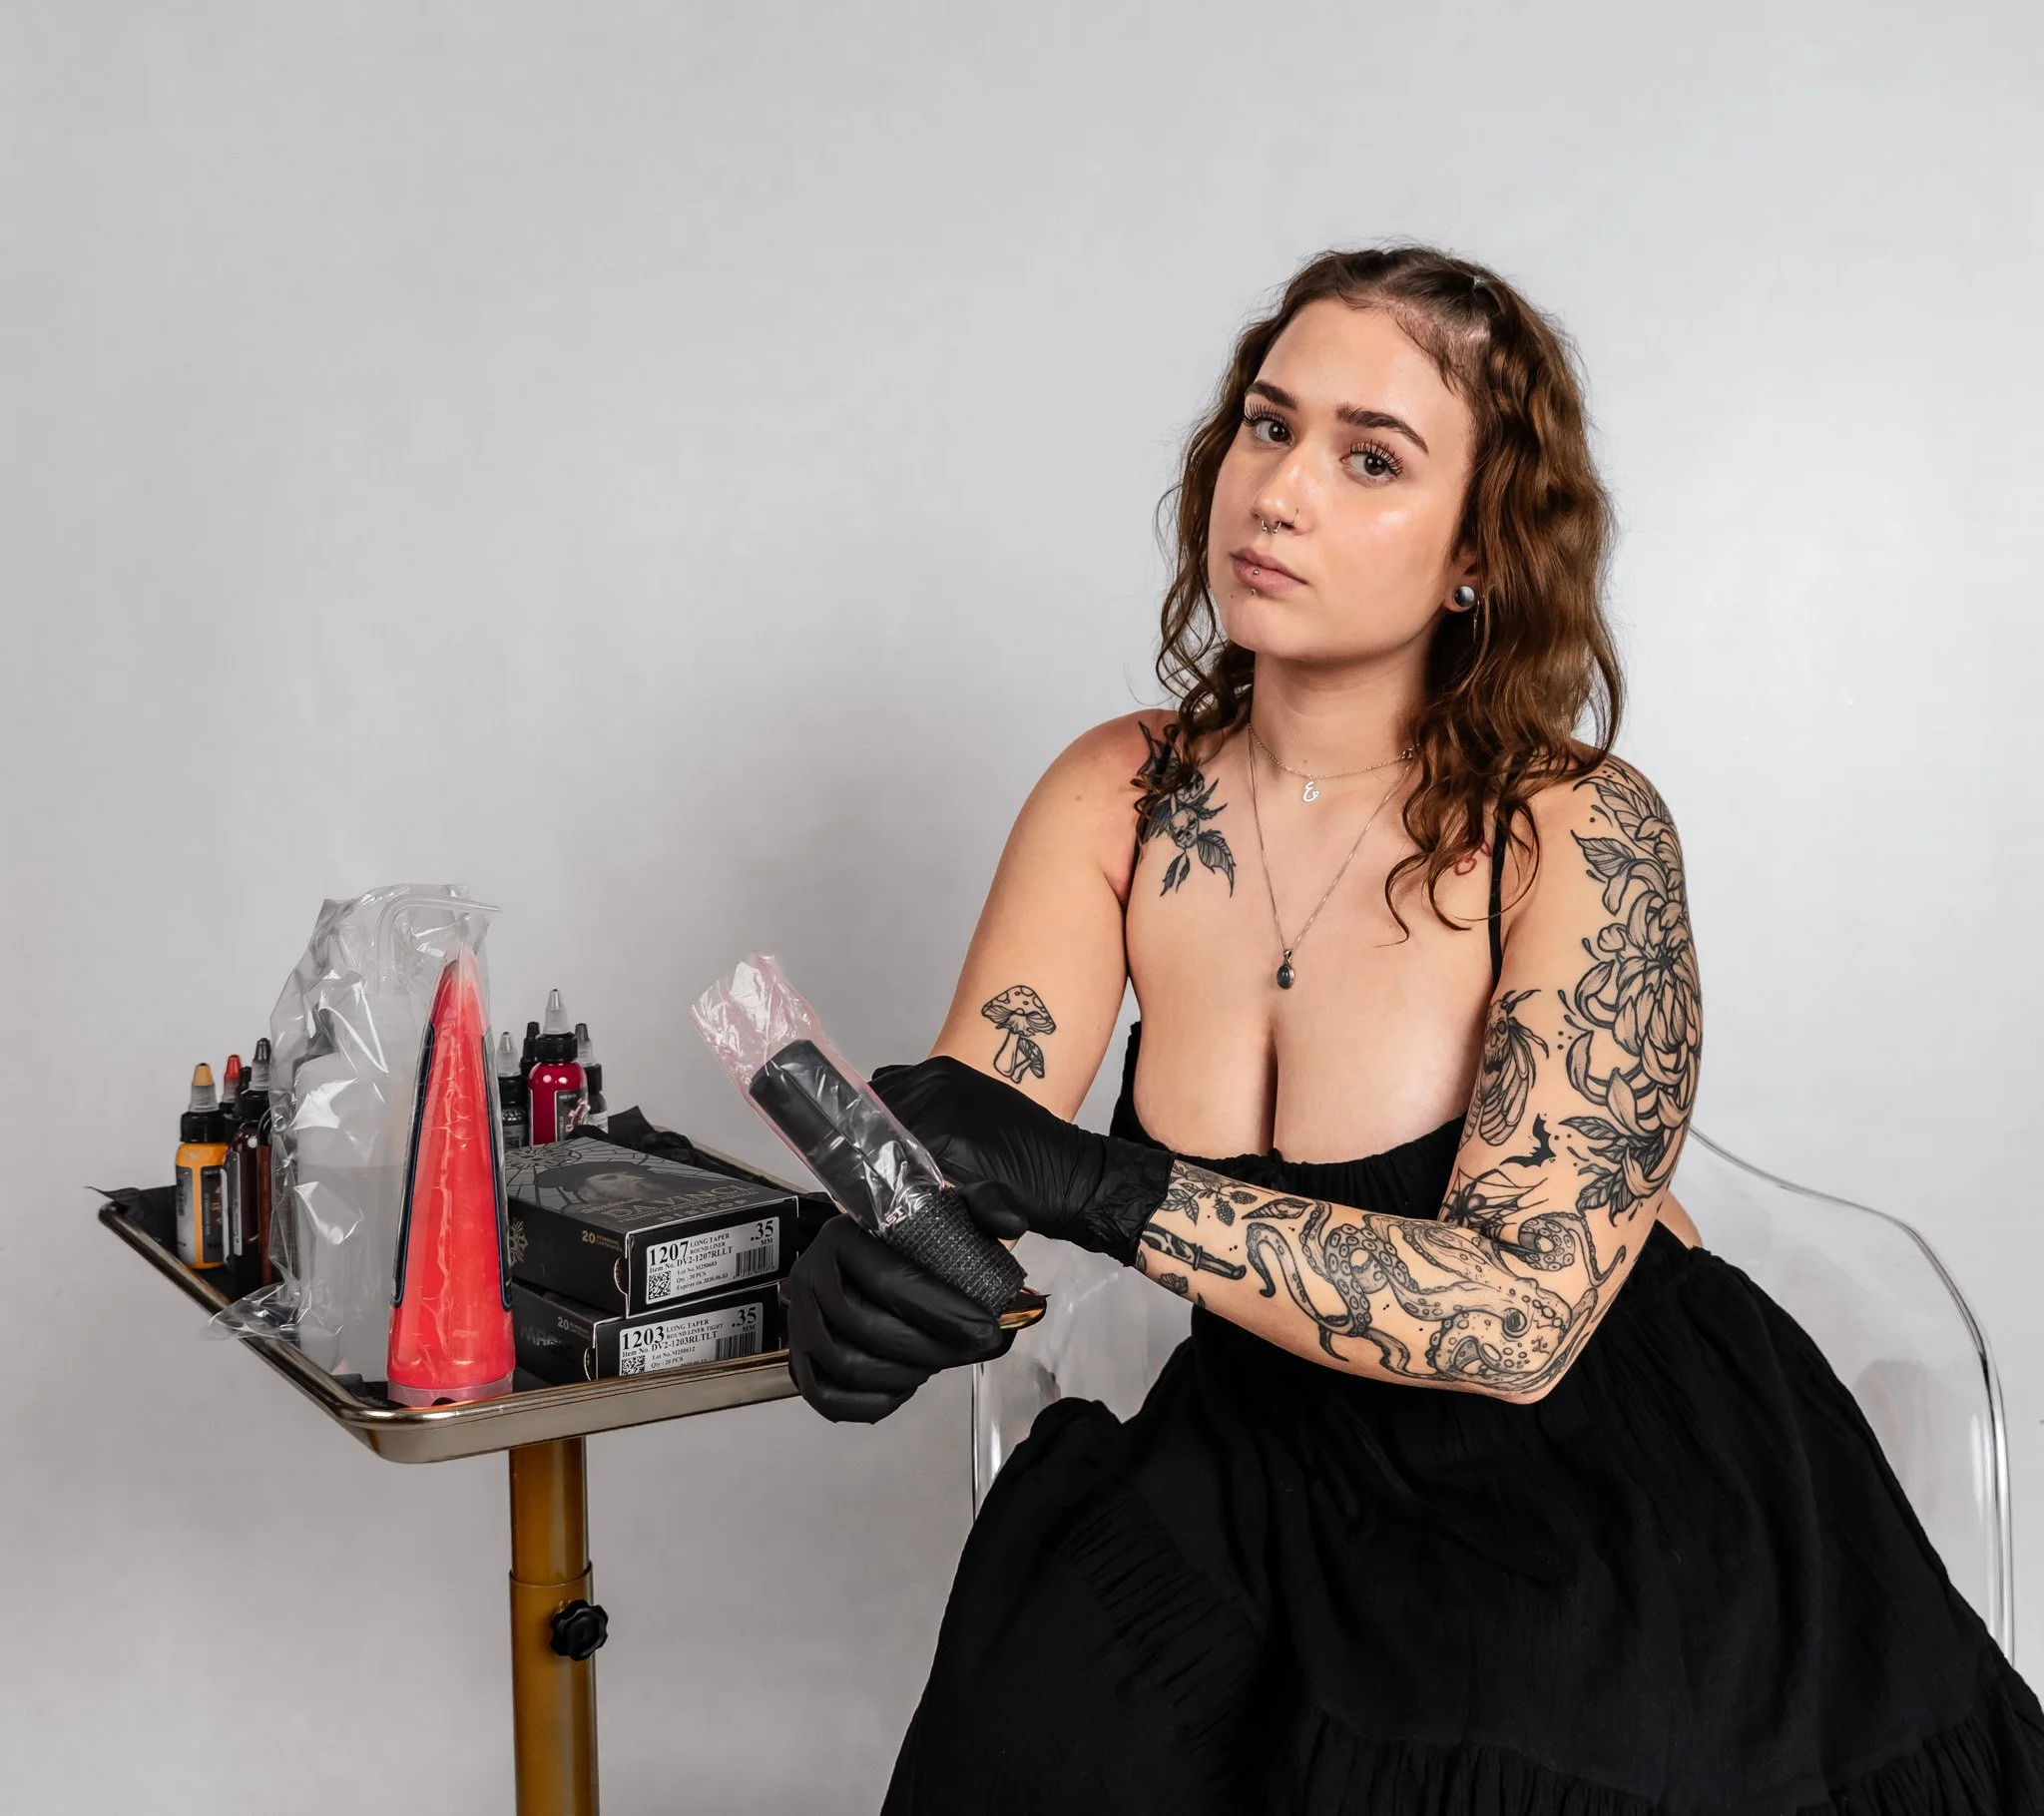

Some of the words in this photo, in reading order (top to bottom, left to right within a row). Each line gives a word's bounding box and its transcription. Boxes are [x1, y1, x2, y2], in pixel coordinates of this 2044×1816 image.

[581, 1229, 596, 1244] 20
[751, 1220, 773, 1241] .35
[690, 1237, 709, 1247] LONG
[710, 1233, 731, 1243] TAPER
[761, 1237, 773, 1246] MM
[650, 1240, 690, 1267] 1207
[690, 1245, 709, 1255] ROUND
[710, 1242, 726, 1251] LINER
[649, 1265, 664, 1274] Item
[677, 1246, 734, 1267] DV2-1207RLLT
[557, 1316, 570, 1331] 20
[732, 1307, 757, 1328] .35
[666, 1323, 686, 1333] LONG
[688, 1319, 710, 1329] TAPER
[666, 1331, 687, 1340] ROUND
[688, 1327, 706, 1336] LINER
[742, 1324, 756, 1333] MM
[622, 1325, 665, 1350] 1203
[622, 1349, 637, 1358] Item
[651, 1331, 719, 1352] DV2-1203RLTLT
